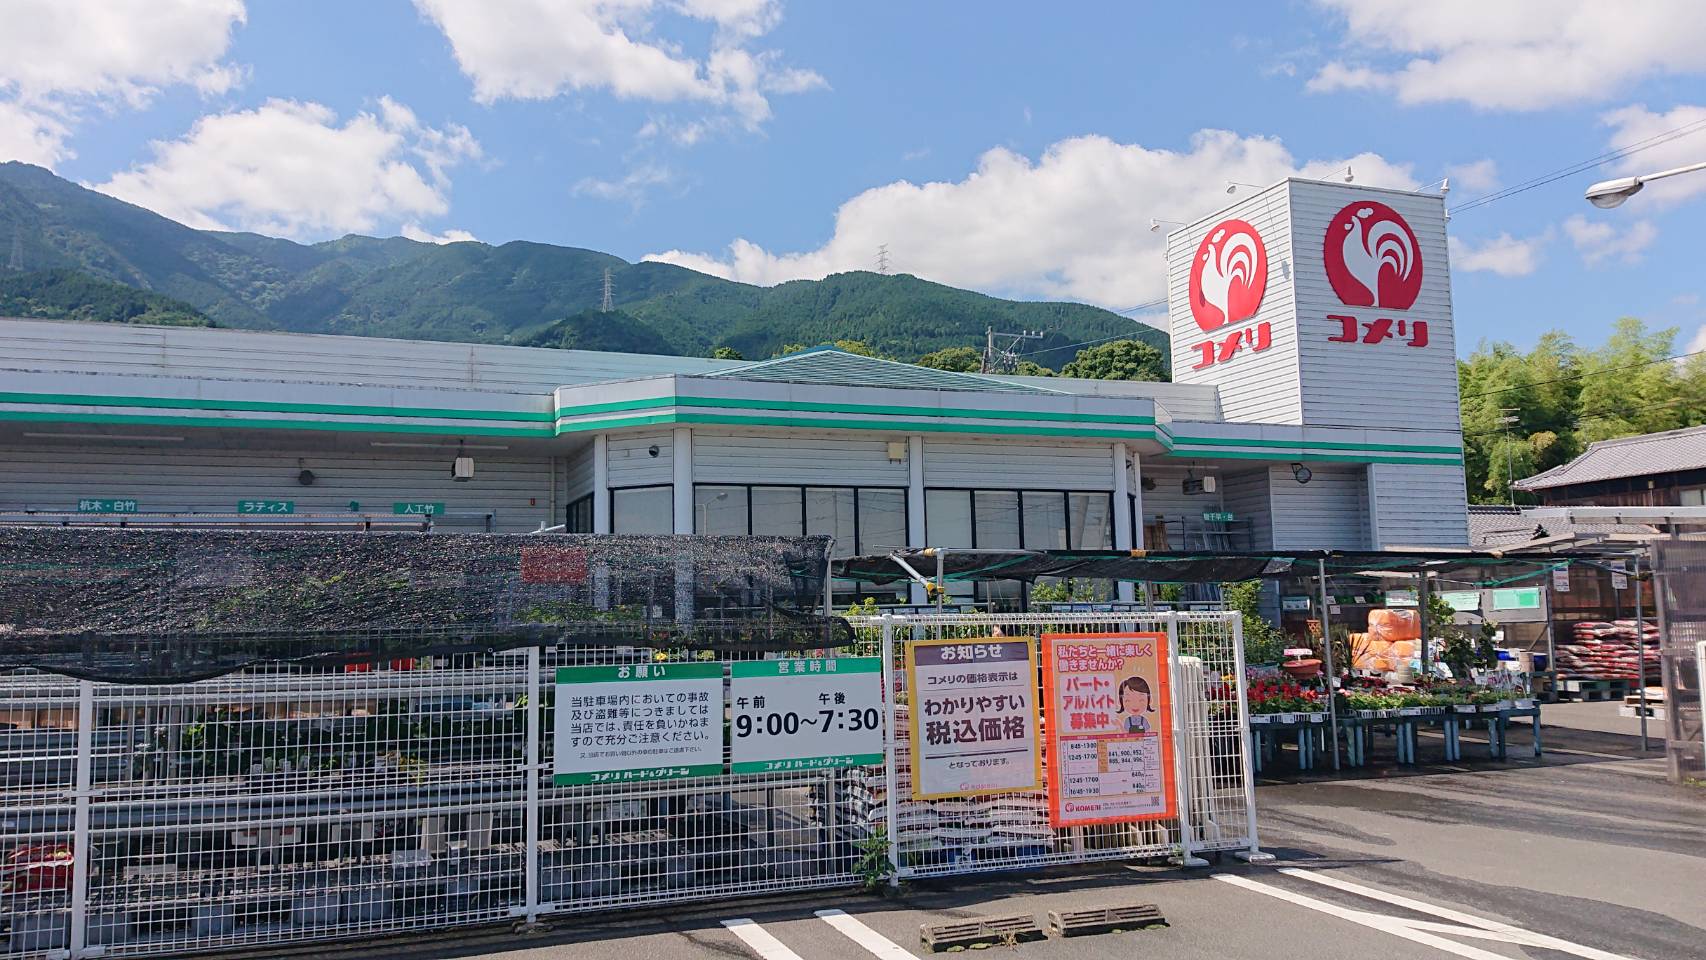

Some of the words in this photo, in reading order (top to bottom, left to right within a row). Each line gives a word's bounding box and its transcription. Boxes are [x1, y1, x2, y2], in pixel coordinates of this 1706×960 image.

[1326, 314, 1429, 347] コメリ
[1191, 321, 1272, 370] コメリ
[244, 502, 288, 512] ラティス
[404, 503, 435, 514] 人工竹
[940, 644, 1003, 660] お知らせ
[1056, 643, 1152, 658] 私たちと一緒に楽しく
[617, 665, 666, 679] お願い
[778, 661, 838, 674] 営業時間
[927, 672, 1018, 685] コメリの価格表示は
[570, 692, 710, 707] 当駐車場内においての事故
[736, 695, 766, 709] 午前
[818, 692, 846, 705] 午後
[924, 694, 1025, 716] わかりやすい
[1063, 694, 1115, 711] アルバイト
[570, 705, 710, 720] 及び盗難等につきましては
[570, 718, 710, 734] 当店では、責任を負いかねま
[1069, 711, 1111, 730] 募集中
[926, 715, 1025, 746] 税込価格
[570, 733, 710, 748] すので充分ご注意ください。
[764, 761, 792, 770] コメリ
[949, 758, 1010, 769] となっております。
[591, 771, 621, 782] コメリ
